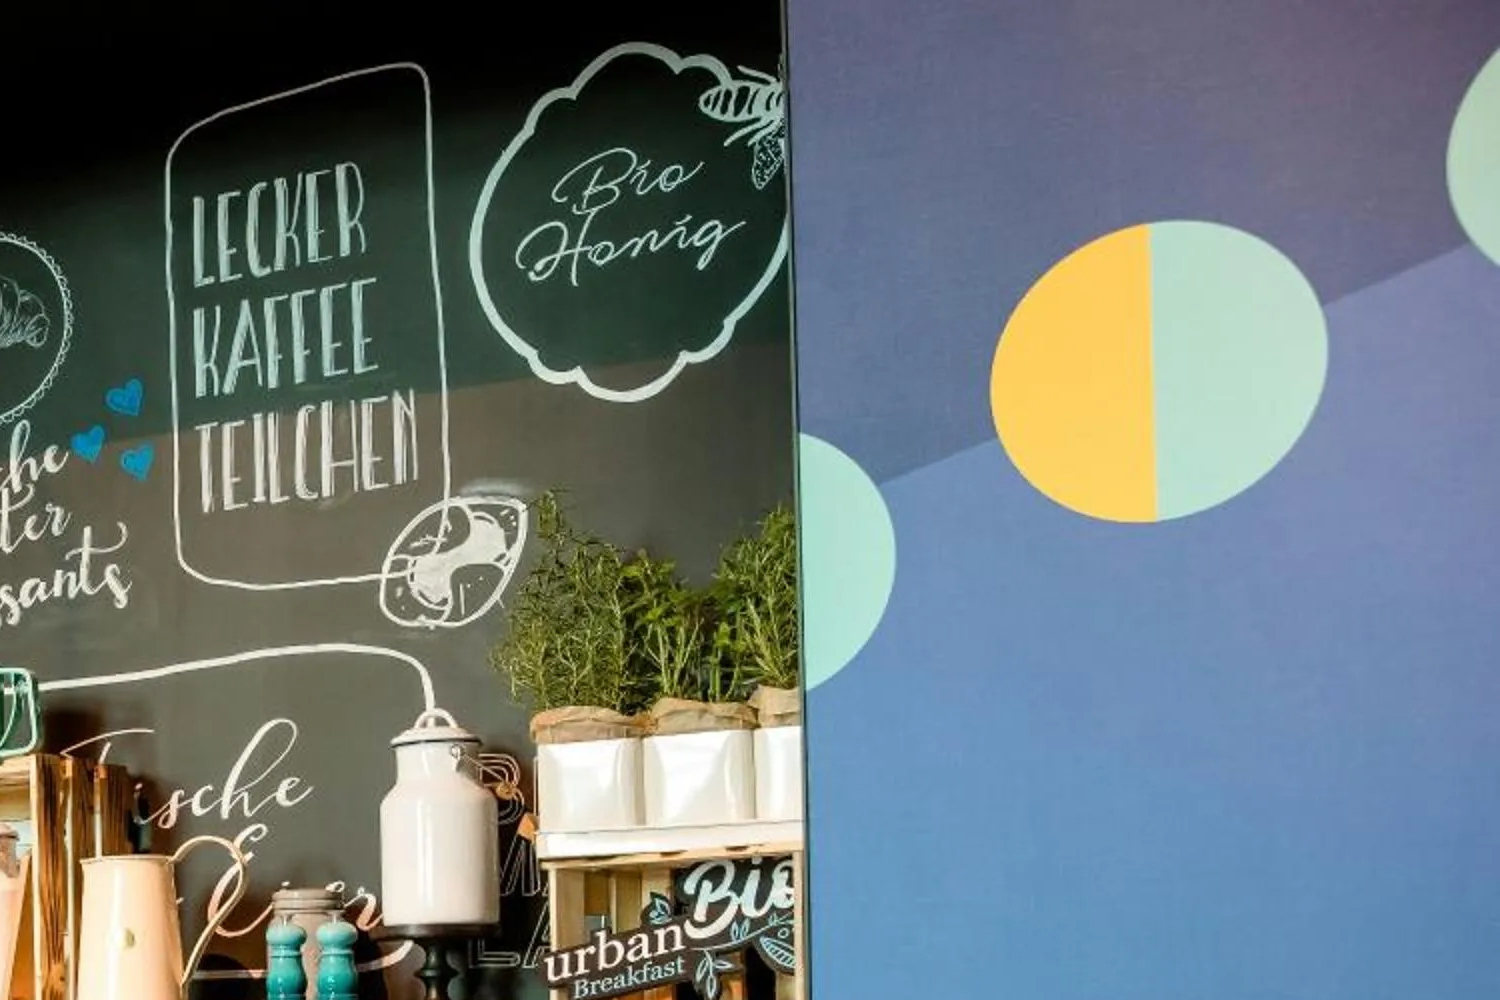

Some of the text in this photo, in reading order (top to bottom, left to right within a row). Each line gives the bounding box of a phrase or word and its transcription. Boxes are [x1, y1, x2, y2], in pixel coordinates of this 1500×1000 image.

[551, 147, 704, 214] Bio
[193, 161, 366, 288] LECKER
[515, 208, 746, 286] Honig
[193, 278, 379, 399] KAFFEE
[195, 388, 419, 514] TEILCHEN
[543, 923, 688, 983] urban
[573, 954, 687, 999] Breakfast
